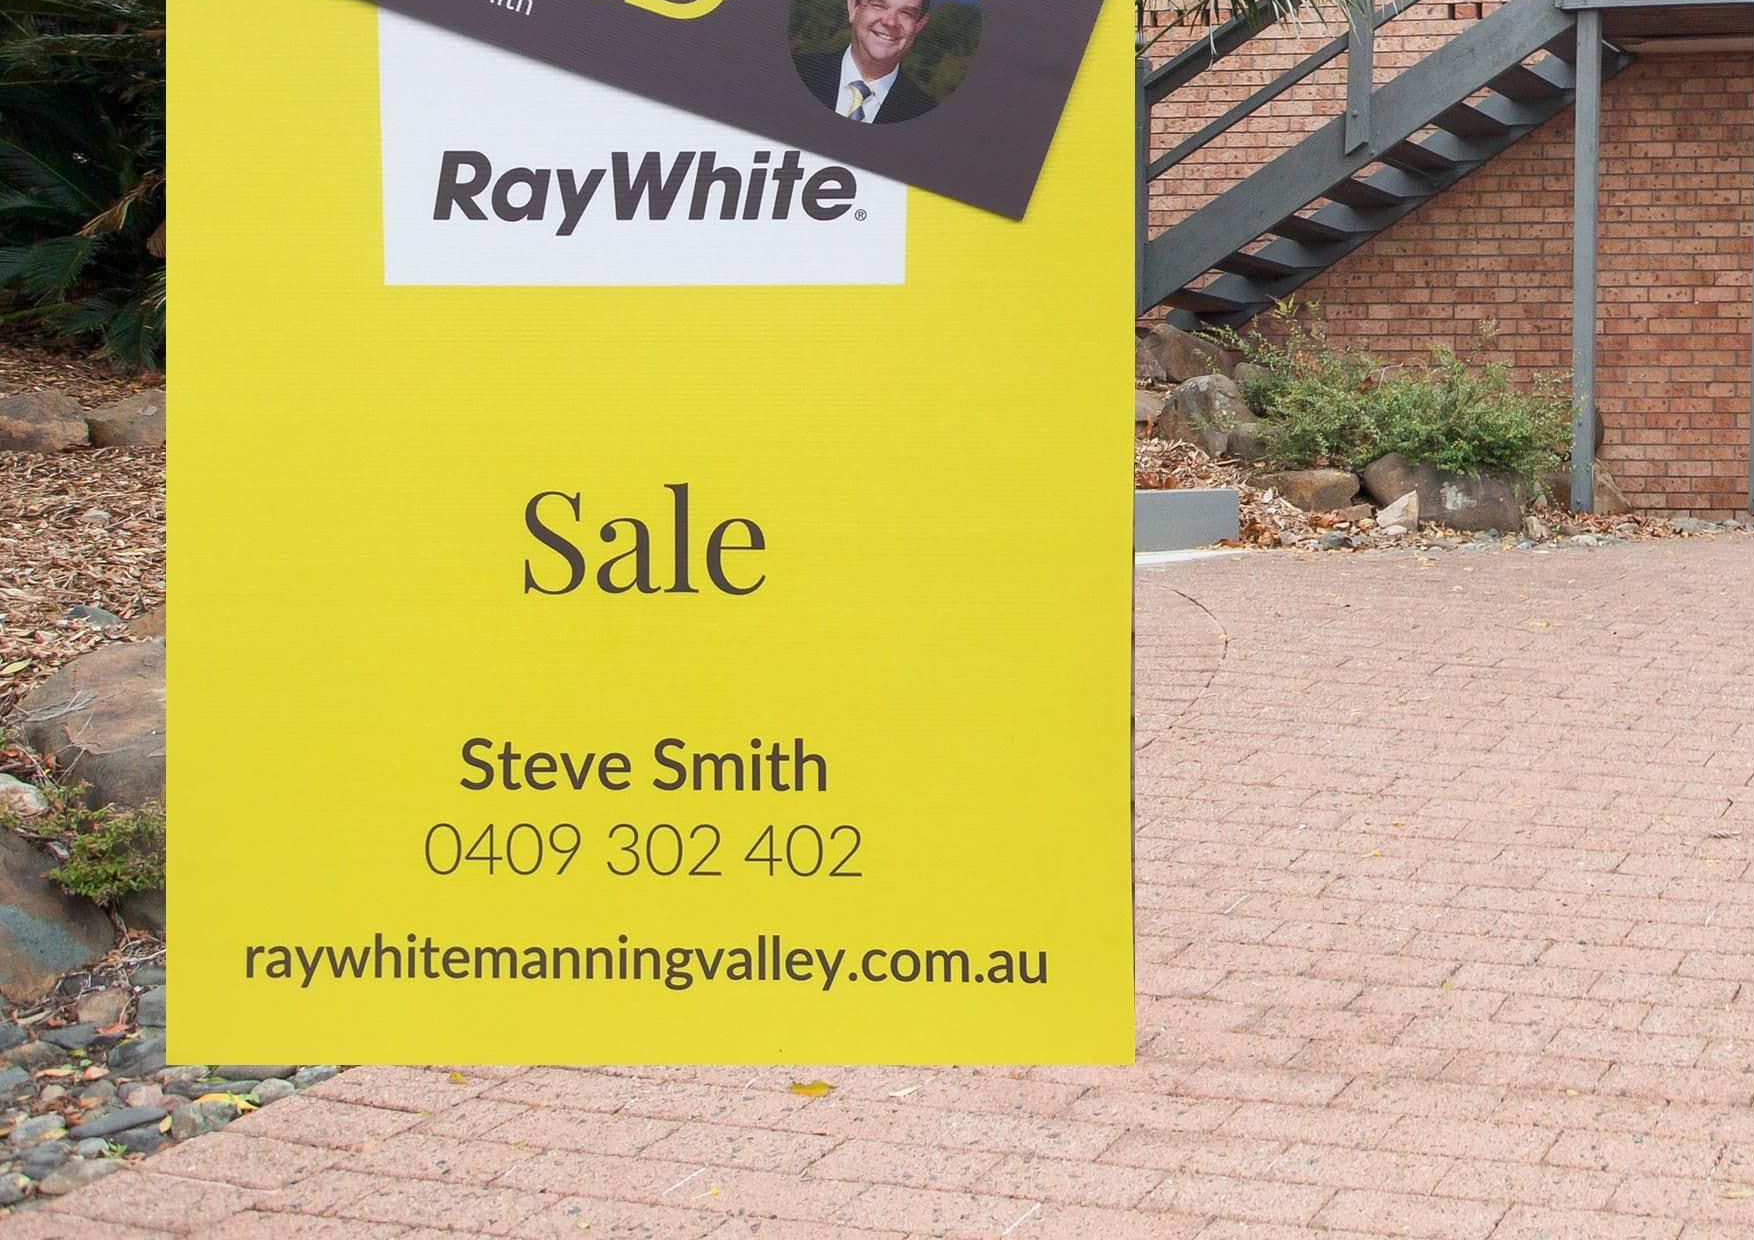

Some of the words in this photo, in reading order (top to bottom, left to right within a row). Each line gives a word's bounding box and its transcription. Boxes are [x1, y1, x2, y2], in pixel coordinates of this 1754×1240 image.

[524, 482, 767, 596] Sale
[460, 737, 632, 792] Steve
[652, 737, 827, 792] Smith
[425, 823, 581, 877] 0409
[605, 823, 723, 877] 302
[743, 824, 864, 878] 402
[245, 932, 1048, 992] raywhitemanningvalley.com.au
